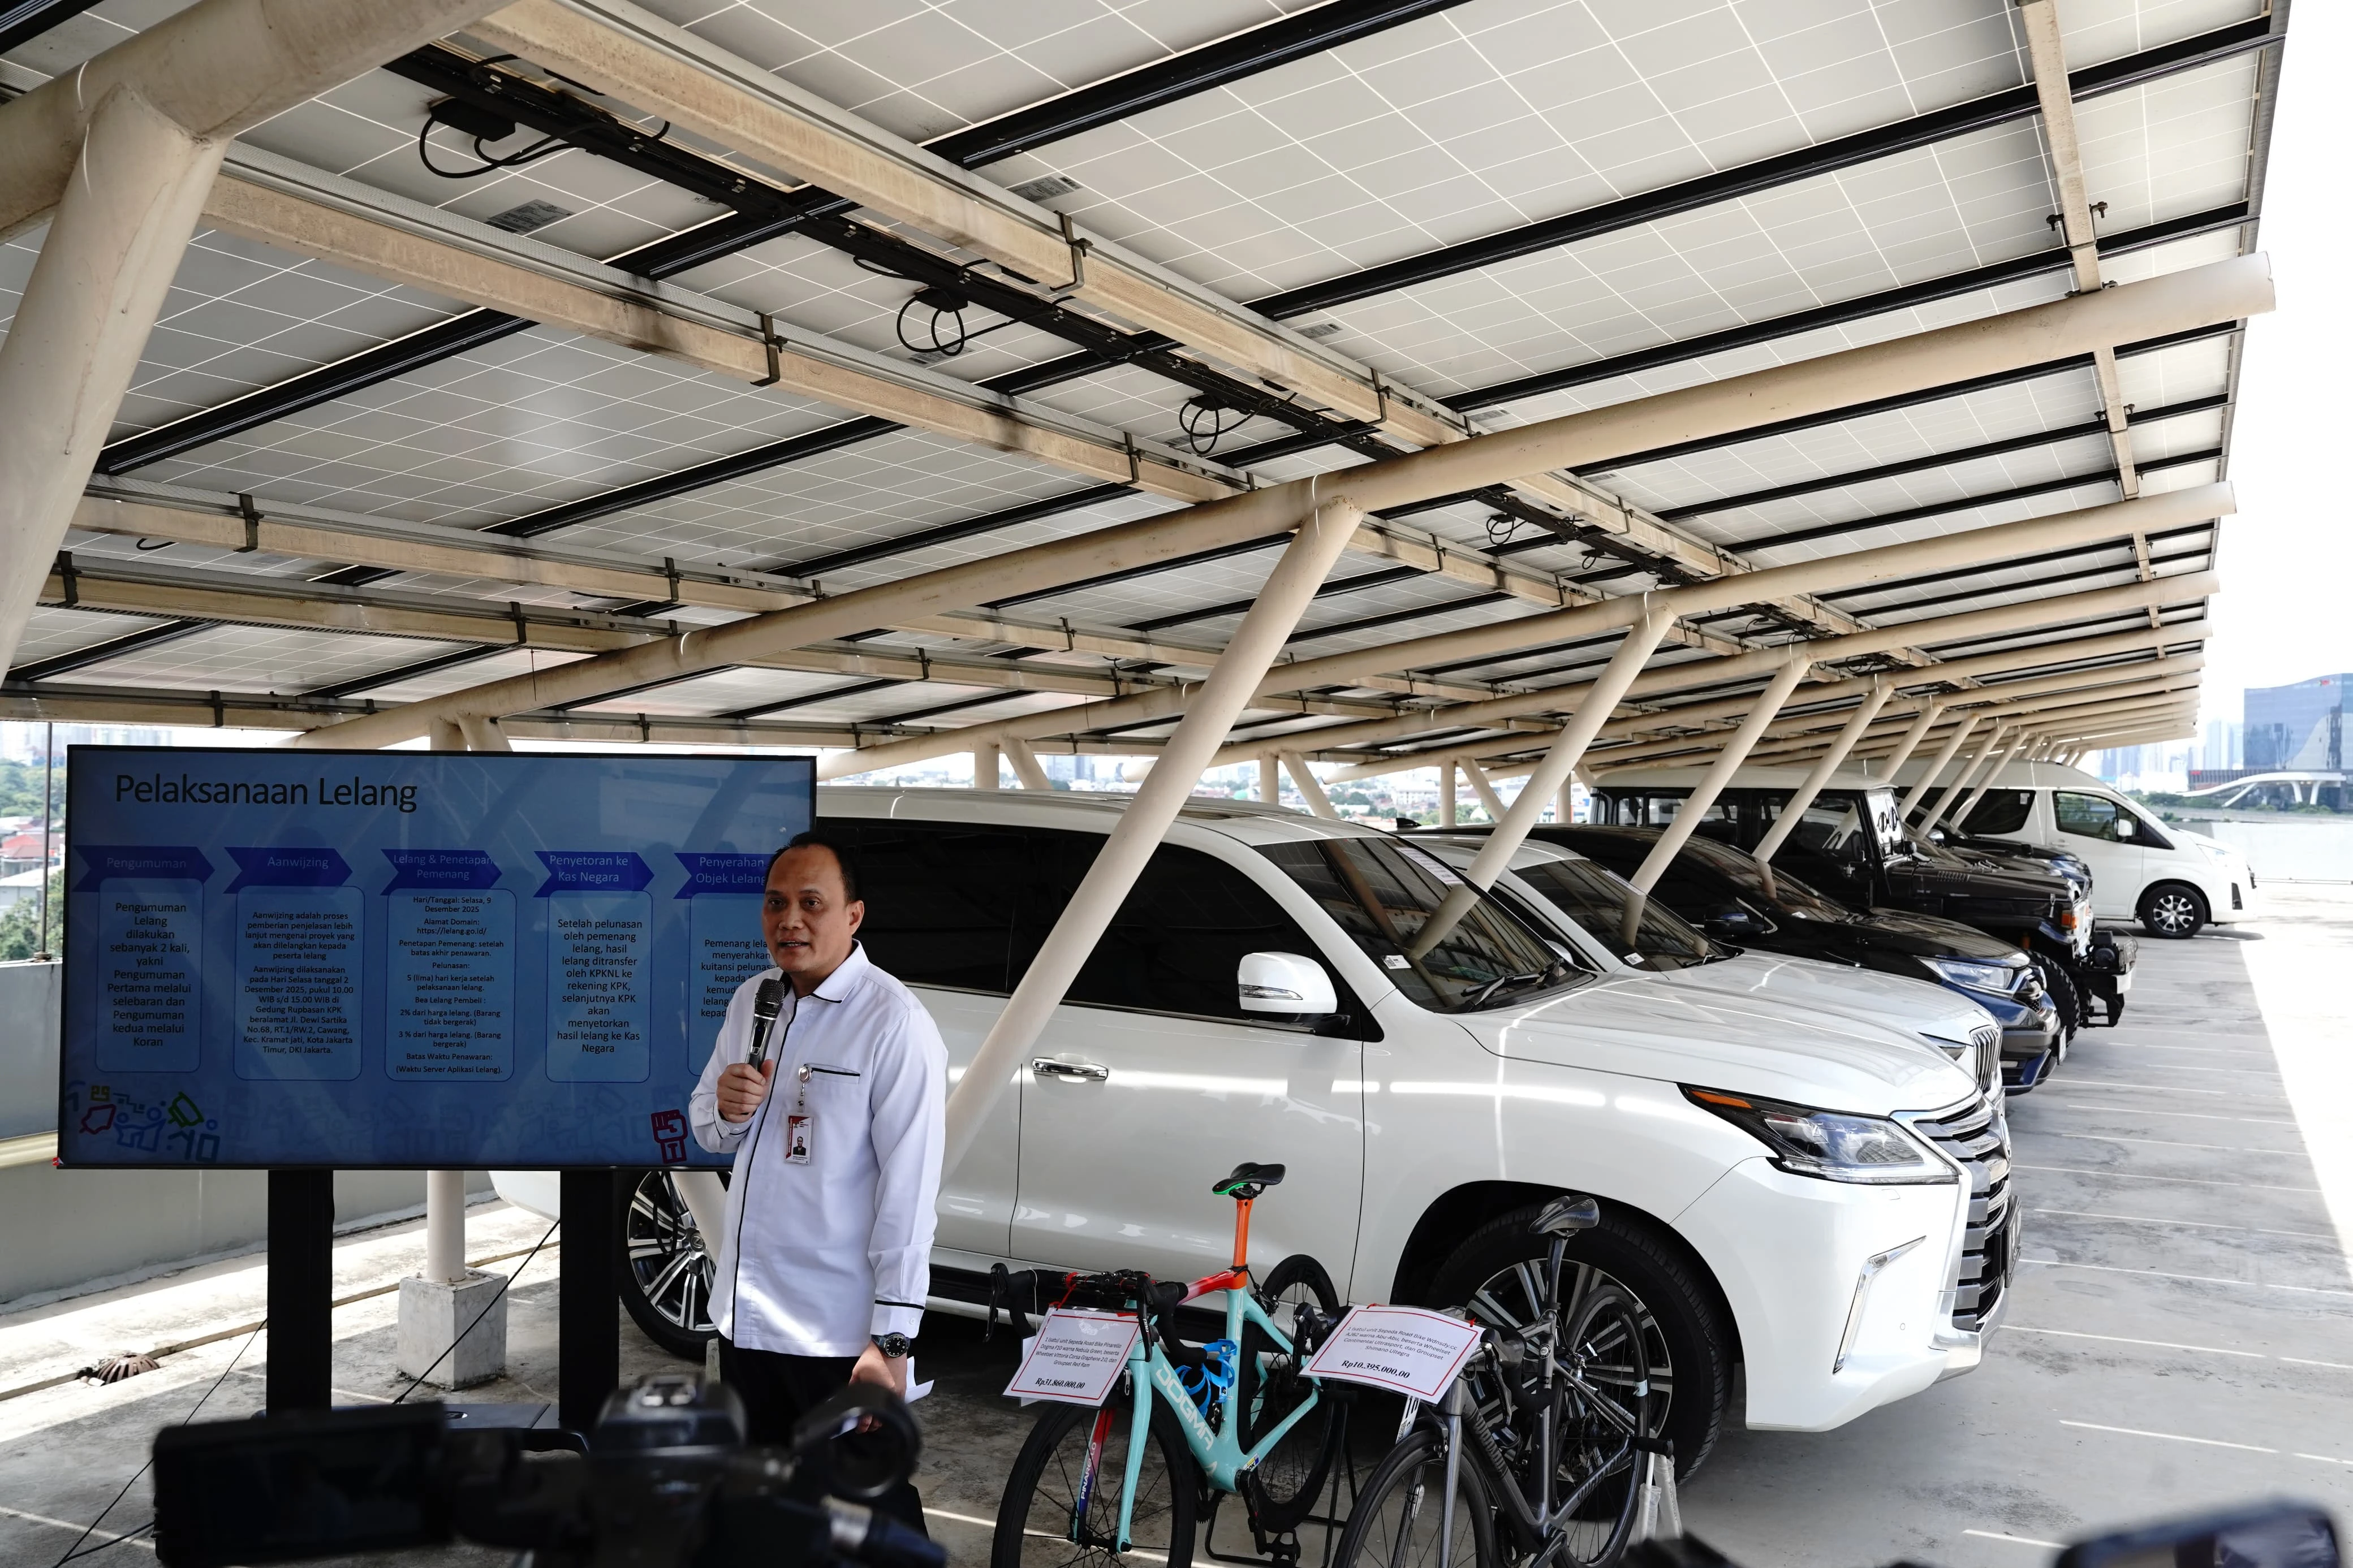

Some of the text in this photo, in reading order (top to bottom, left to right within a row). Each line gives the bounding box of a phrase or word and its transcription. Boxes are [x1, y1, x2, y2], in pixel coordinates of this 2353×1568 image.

[117, 774, 417, 813] Pelaksanaan Lelang
[107, 857, 186, 870] Pengumuman
[268, 857, 329, 869] Aanwijzing
[394, 854, 494, 867] Lelang & Penetapan
[550, 855, 628, 867] Penyetoran ke
[700, 857, 764, 869] Penyerahan
[416, 869, 470, 882] Pemenang
[559, 871, 619, 884] Kas Negara
[696, 873, 765, 885] Objek Lelang
[413, 896, 460, 905] Hari/Tanggal:
[116, 902, 186, 914] Pengumuman
[135, 916, 167, 927] Lelang
[253, 912, 294, 921] Aanwijzing
[248, 921, 289, 930] pemberian
[291, 922, 332, 931] penjelasan
[558, 919, 642, 930] Setelah pelunasan
[126, 929, 175, 939] dilakukan
[245, 931, 267, 940] lanjut
[269, 932, 307, 940] mengenai
[309, 932, 335, 940] proyek
[417, 927, 486, 935] https://lelang.go.id/
[564, 931, 636, 943] oleh pemenang
[110, 943, 189, 954] sebanyak 2 kali,
[273, 941, 317, 951] dilelangkan
[318, 941, 346, 950] kepada
[573, 944, 627, 954] lelang, hasil
[705, 939, 750, 949] Pemenang
[304, 952, 326, 961] lelang
[712, 952, 770, 960] menyerahkan
[136, 956, 163, 967] yakni
[562, 956, 637, 967] lelang ditransfer
[253, 966, 294, 974] Aanwijzing
[566, 969, 632, 978] oleh KPKNL ke
[114, 970, 185, 981] Pengumuman
[249, 975, 269, 984] pada
[314, 976, 342, 984] tanggal
[715, 974, 745, 983] kepada
[107, 983, 191, 993] Pertama melalui
[286, 986, 307, 995] 2025,
[309, 986, 330, 995] pukul
[568, 981, 630, 992] rekening KPK,
[113, 996, 185, 1006] selebaran dan
[277, 995, 289, 1004] s/d
[562, 994, 615, 1004] selanjutnya
[704, 997, 730, 1007] lelang
[256, 1005, 286, 1014] Gedung
[287, 1006, 325, 1014] Rupbasan
[588, 1006, 610, 1015] akan
[701, 1009, 726, 1018] kepad
[113, 1010, 184, 1022] Pengumuman
[113, 1023, 184, 1033] kedua melalui
[568, 1019, 629, 1029] menyetorkan
[557, 1031, 640, 1042] hasil lelang ke Kas
[133, 1037, 163, 1047] Koran
[582, 1044, 614, 1054] Negara
[1374, 1341, 1403, 1349] Ultrasport,
[1417, 1349, 1443, 1360] Groupset
[1401, 1338, 1423, 1346] beserta
[1424, 1343, 1450, 1355] Wheelset
[1035, 1378, 1085, 1389] Rp31.860.000,00
[1156, 1363, 1214, 1452] DOGMA
